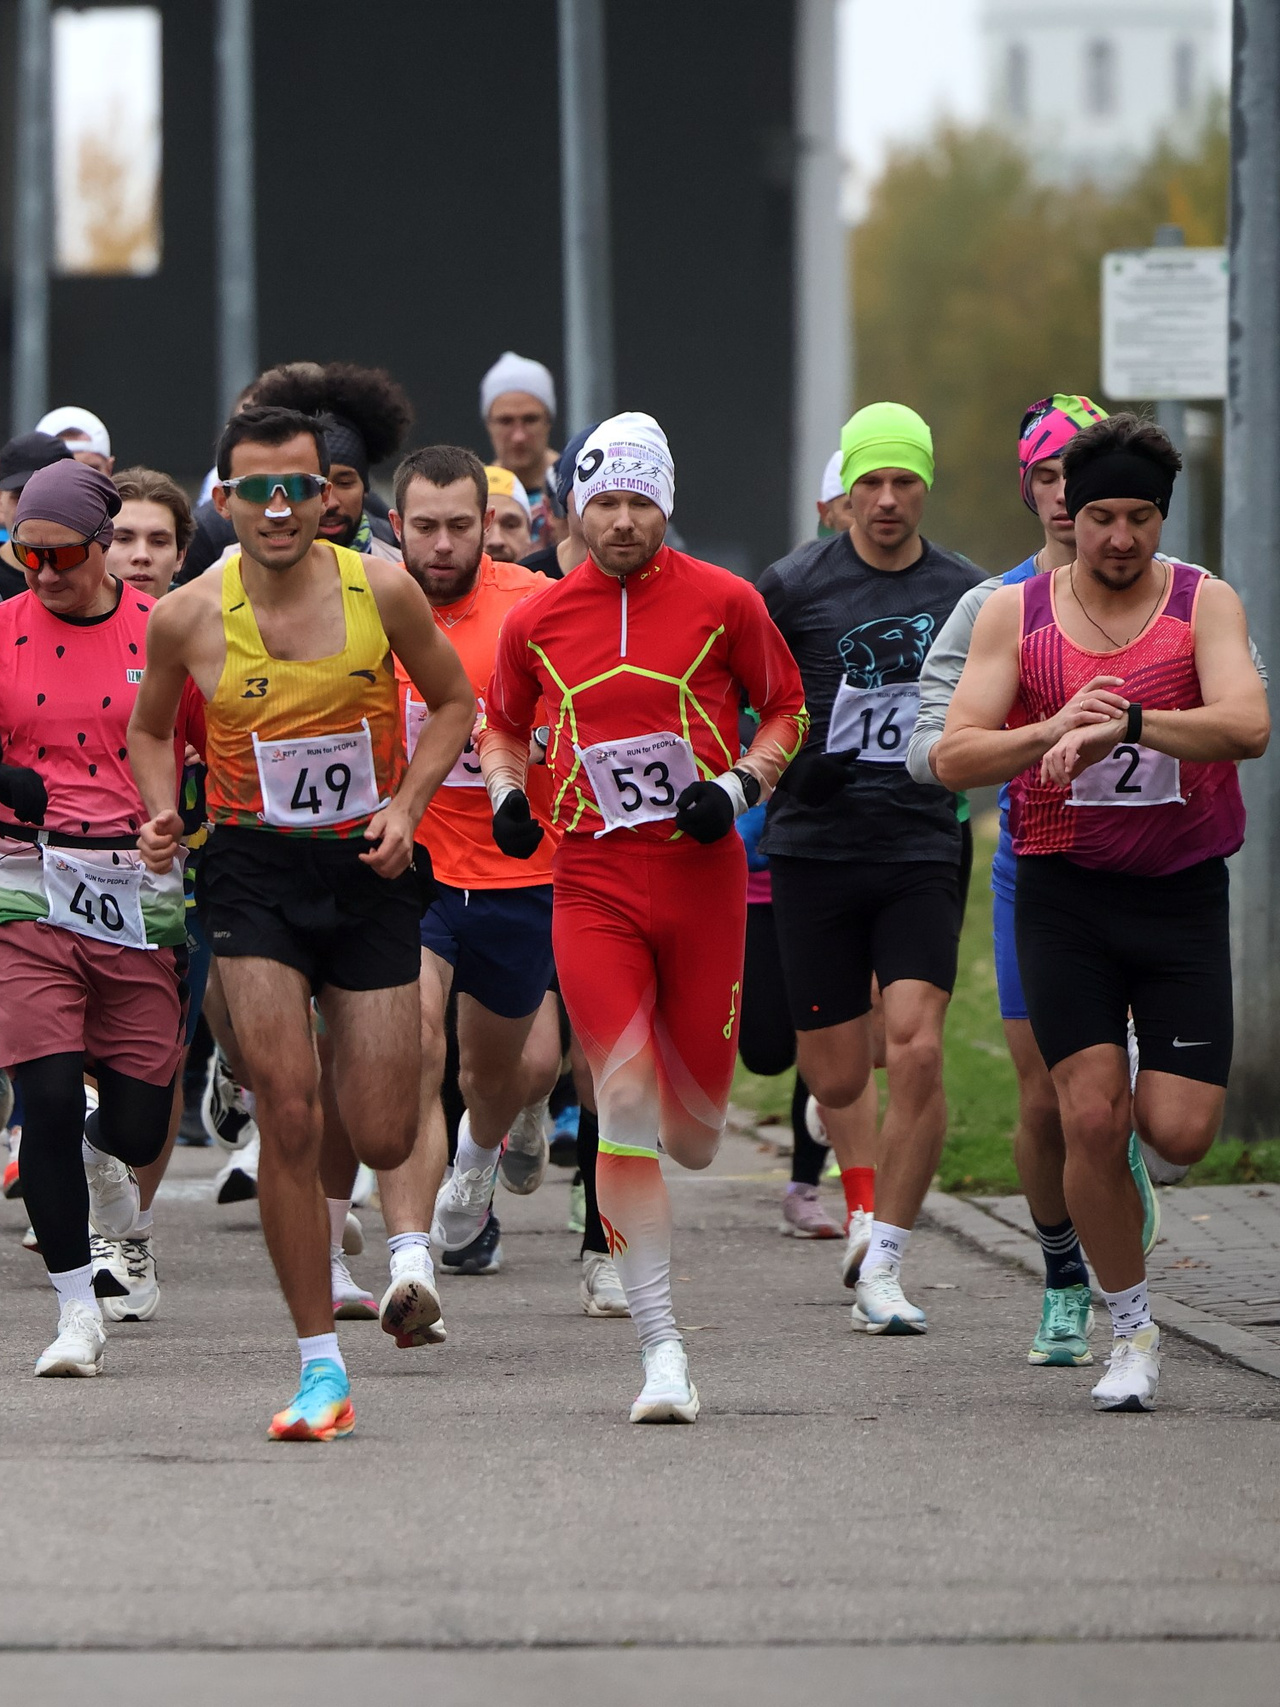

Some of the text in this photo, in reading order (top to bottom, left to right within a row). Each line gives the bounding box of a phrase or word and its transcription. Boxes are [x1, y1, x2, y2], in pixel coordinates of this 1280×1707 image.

[307, 748, 322, 756] RUN
[333, 741, 357, 753] PEOPLE
[627, 749, 641, 757] RUN
[652, 739, 677, 751] PEOPLE
[860, 707, 901, 750] 16
[290, 763, 352, 814] 49
[612, 761, 675, 812] 53
[1113, 746, 1141, 793] 2
[84, 873, 97, 882] RUN
[70, 881, 125, 931] 40
